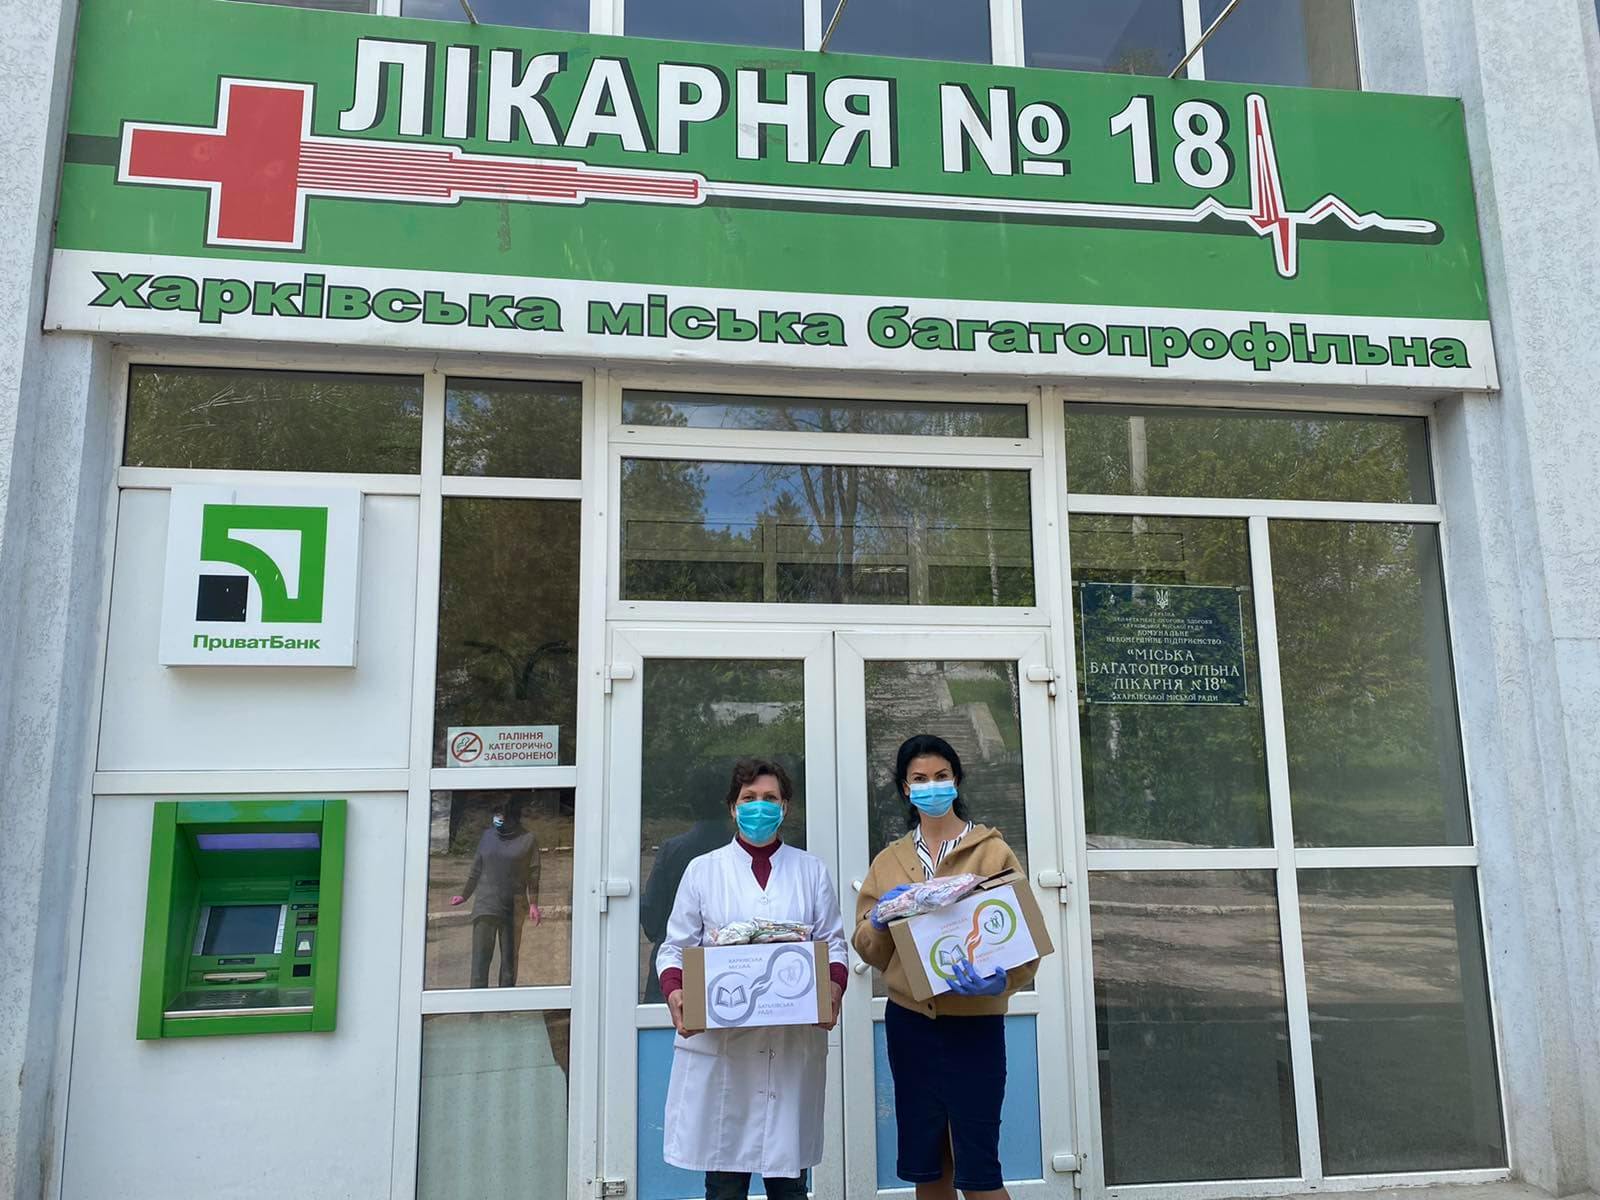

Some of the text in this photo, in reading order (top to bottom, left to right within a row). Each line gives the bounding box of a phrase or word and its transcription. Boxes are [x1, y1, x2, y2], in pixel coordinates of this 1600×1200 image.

[339, 38, 1234, 189] ЛІКАРНЯ № 18
[91, 270, 1471, 371] харківська міська багатопрофільна
[192, 634, 321, 651] ПриватБанк
[1089, 662, 1240, 677] БАГАТОПРОФІЛЬНА
[1114, 678, 1184, 691] ЛІКАРНЯ
[498, 732, 544, 741] ПАЛІННЯ
[488, 742, 553, 750] КАТЕГОРИЧНО
[483, 751, 557, 761] ЗАБОРОНЕНО!
